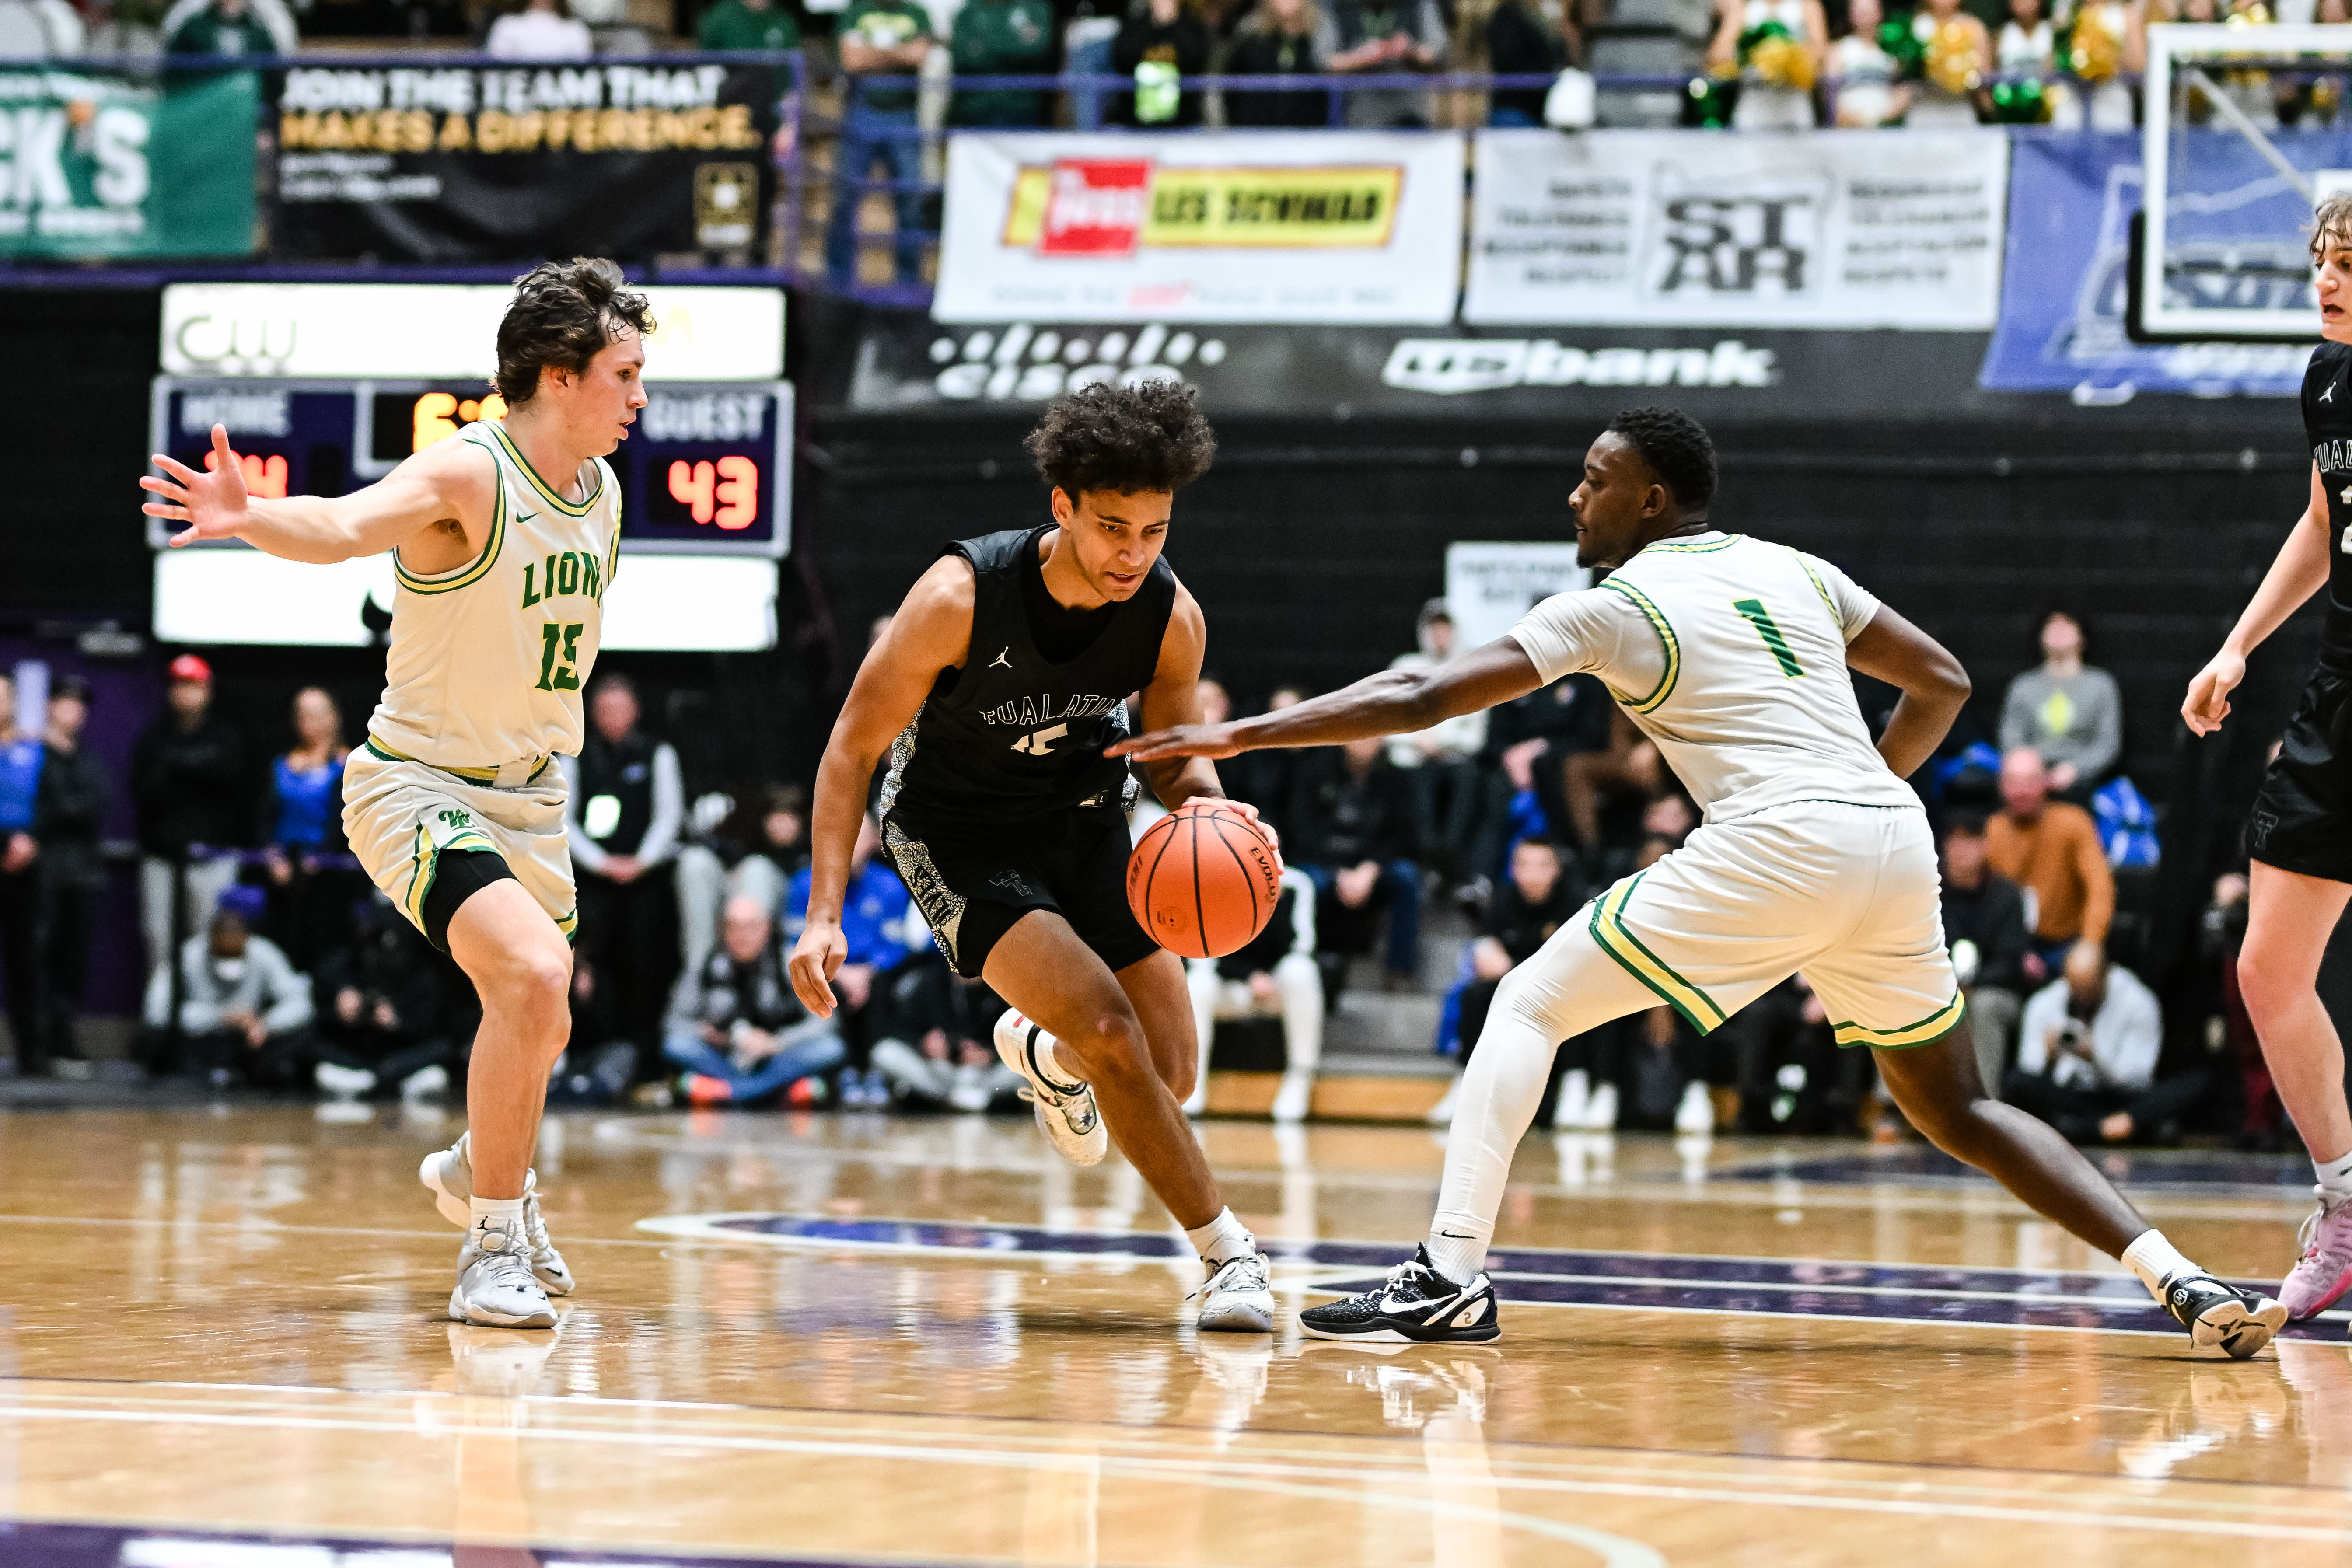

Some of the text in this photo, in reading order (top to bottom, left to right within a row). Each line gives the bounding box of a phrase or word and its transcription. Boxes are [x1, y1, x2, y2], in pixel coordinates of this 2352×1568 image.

[181, 392, 290, 437] HOME
[641, 395, 766, 442] GUEST
[668, 456, 758, 530] 43
[534, 623, 584, 691] 15
[1733, 599, 1805, 678] 1
